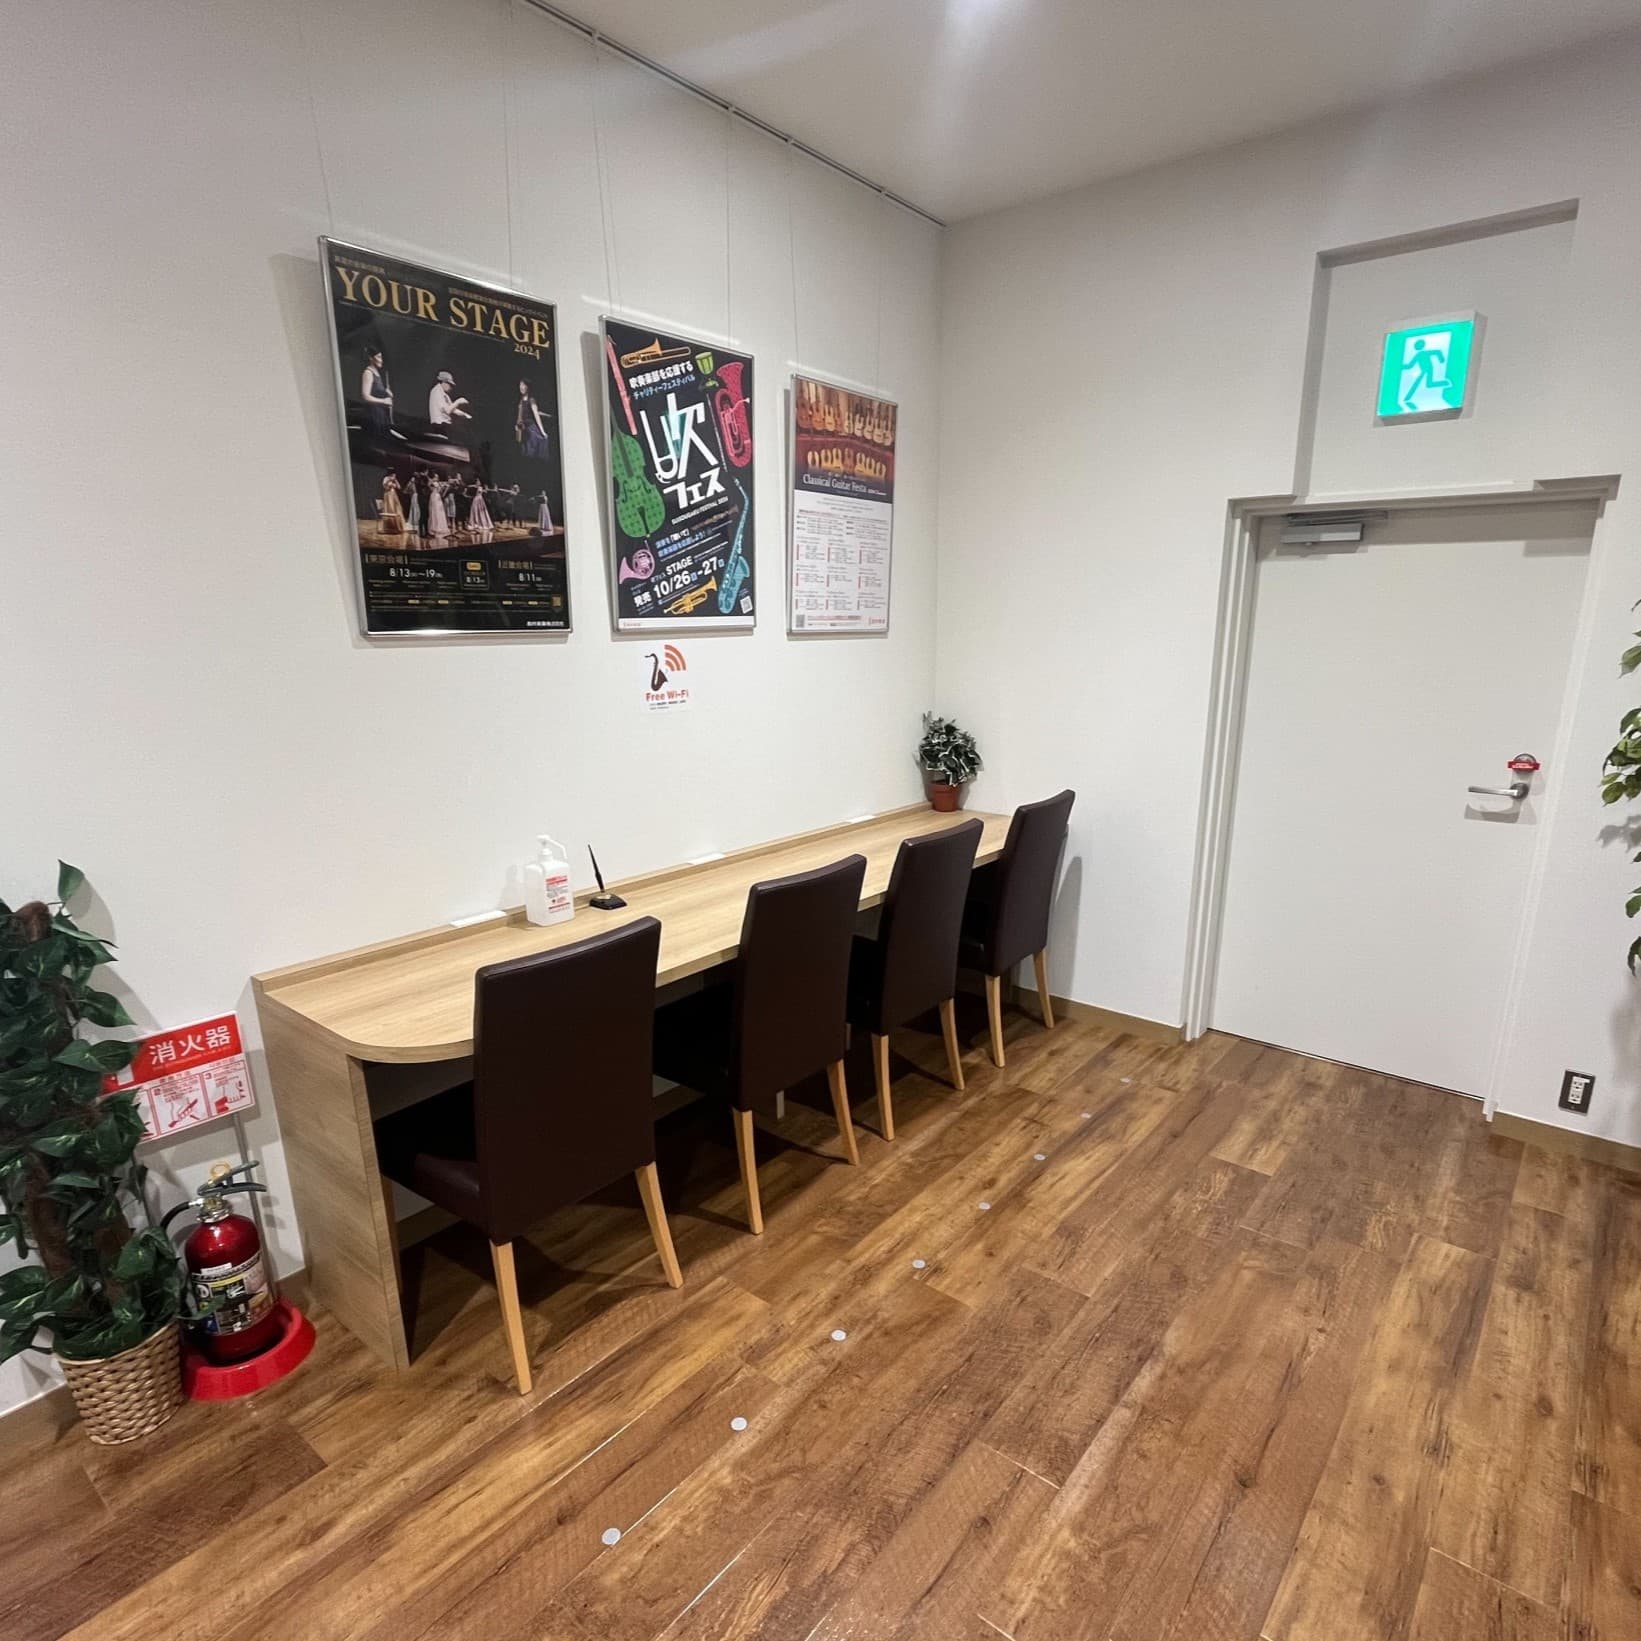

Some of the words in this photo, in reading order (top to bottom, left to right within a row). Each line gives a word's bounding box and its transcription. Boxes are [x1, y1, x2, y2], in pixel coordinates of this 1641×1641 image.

[336, 266, 439, 322] YOUR
[449, 297, 550, 348] STAGE
[514, 343, 541, 360] 2024
[662, 467, 726, 510] フェス
[665, 556, 694, 575] STAGE
[645, 692, 665, 702] Free
[666, 689, 689, 700] Wi-Fi
[149, 1025, 231, 1065] 消火器
